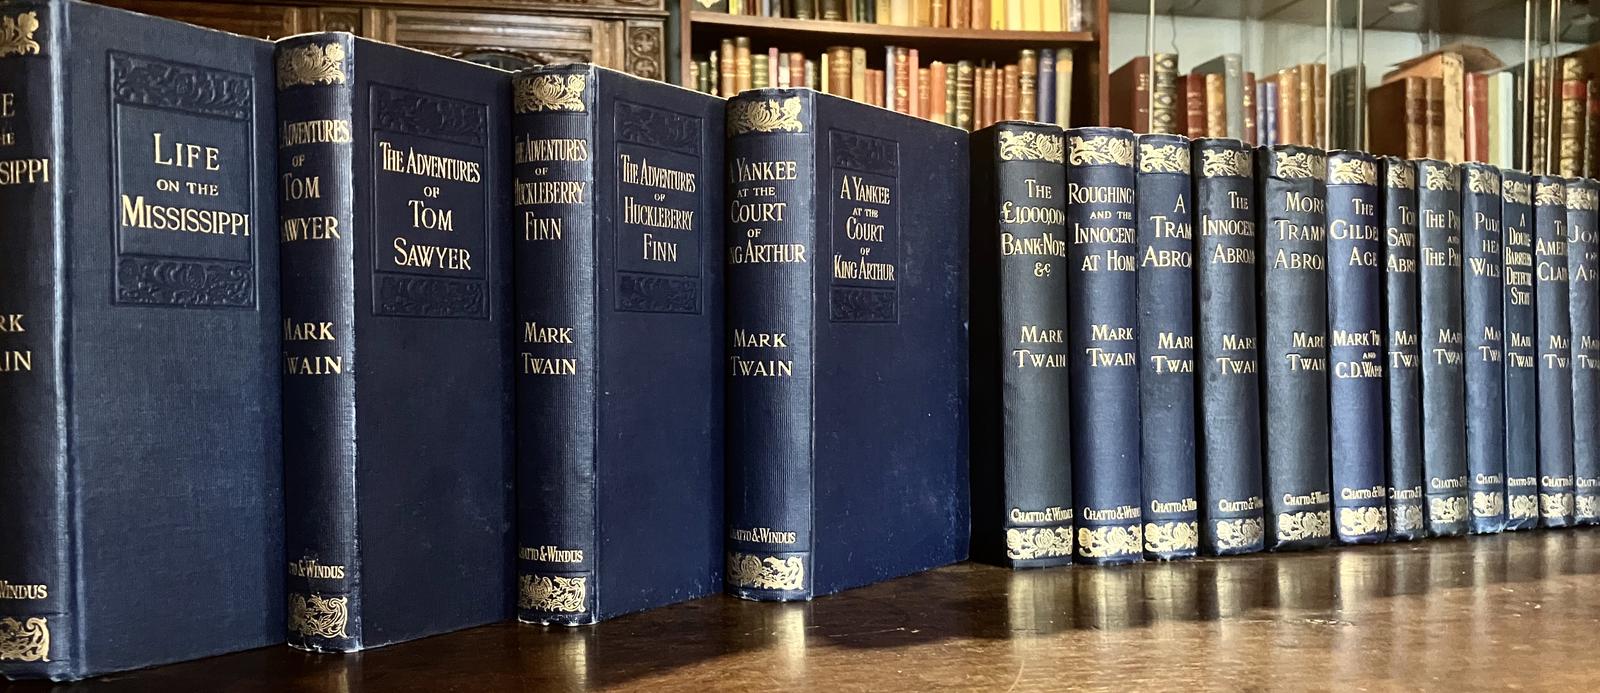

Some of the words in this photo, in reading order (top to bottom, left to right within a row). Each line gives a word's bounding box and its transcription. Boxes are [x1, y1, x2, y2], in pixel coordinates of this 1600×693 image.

[153, 133, 220, 171] LIFE
[526, 133, 588, 162] ADVENTURES
[292, 154, 305, 168] OF
[380, 142, 404, 174] THE
[407, 146, 481, 183] ADVENTURES
[736, 157, 797, 182] YANKEE
[534, 167, 549, 176] OF
[621, 154, 639, 185] THE
[640, 158, 695, 192] ADVENTURES
[156, 179, 180, 193] ON
[186, 182, 219, 196] THE
[283, 173, 320, 201] TOM
[424, 186, 440, 198] OF
[515, 177, 586, 206] HUCKLEBERRY
[653, 192, 666, 202] OF
[737, 188, 749, 198] AT
[753, 186, 776, 197] THE
[840, 175, 852, 200] A
[853, 176, 890, 205] YANKEE
[1024, 179, 1052, 199] THE
[1069, 183, 1132, 204] ROUGHING
[1174, 194, 1186, 213] A
[1228, 191, 1249, 210] THE
[1352, 198, 1373, 216] THE
[121, 194, 250, 236] MISSISSIPPI
[408, 200, 454, 231] TOM
[624, 196, 694, 231] HUCKLEBERRY
[731, 200, 787, 224] COURT
[852, 207, 862, 217] AT
[864, 208, 879, 218] THE
[1090, 211, 1112, 220] AND
[1117, 211, 1132, 220] THE
[1423, 209, 1445, 228] THE
[1519, 213, 1526, 227] A
[282, 216, 340, 243] AWYER
[525, 211, 562, 241] FINN
[747, 228, 761, 239] OF
[846, 216, 884, 242] COURT
[393, 237, 471, 271] SAWYER
[643, 234, 677, 262] FINN
[744, 239, 806, 264] ARTHUR
[860, 247, 871, 256] OF
[1349, 246, 1377, 267] AGE
[1423, 247, 1445, 266] THE
[834, 254, 858, 280] KING
[859, 256, 895, 281] ARTHUR
[1081, 254, 1100, 271] AT
[283, 321, 335, 344] MARK
[524, 322, 573, 344] MARK
[734, 328, 787, 349] MARK
[1020, 326, 1063, 343] MARK
[1092, 324, 1133, 341] MARK
[1333, 330, 1369, 347] MARK
[521, 352, 577, 375] TWAIN
[1013, 348, 1066, 368] TWAIN
[1086, 347, 1136, 367] TWAIN
[1362, 352, 1377, 360] AND
[730, 355, 793, 378] TWAIN
[1341, 487, 1372, 499] CHATTO
[1431, 477, 1459, 489] CHATTO
[1151, 500, 1182, 513] CHATTO
[1219, 499, 1248, 512] CHATTO
[1283, 493, 1310, 506] CHATTO
[1010, 508, 1045, 522] CHATTO
[1083, 507, 1117, 520] CHATTO
